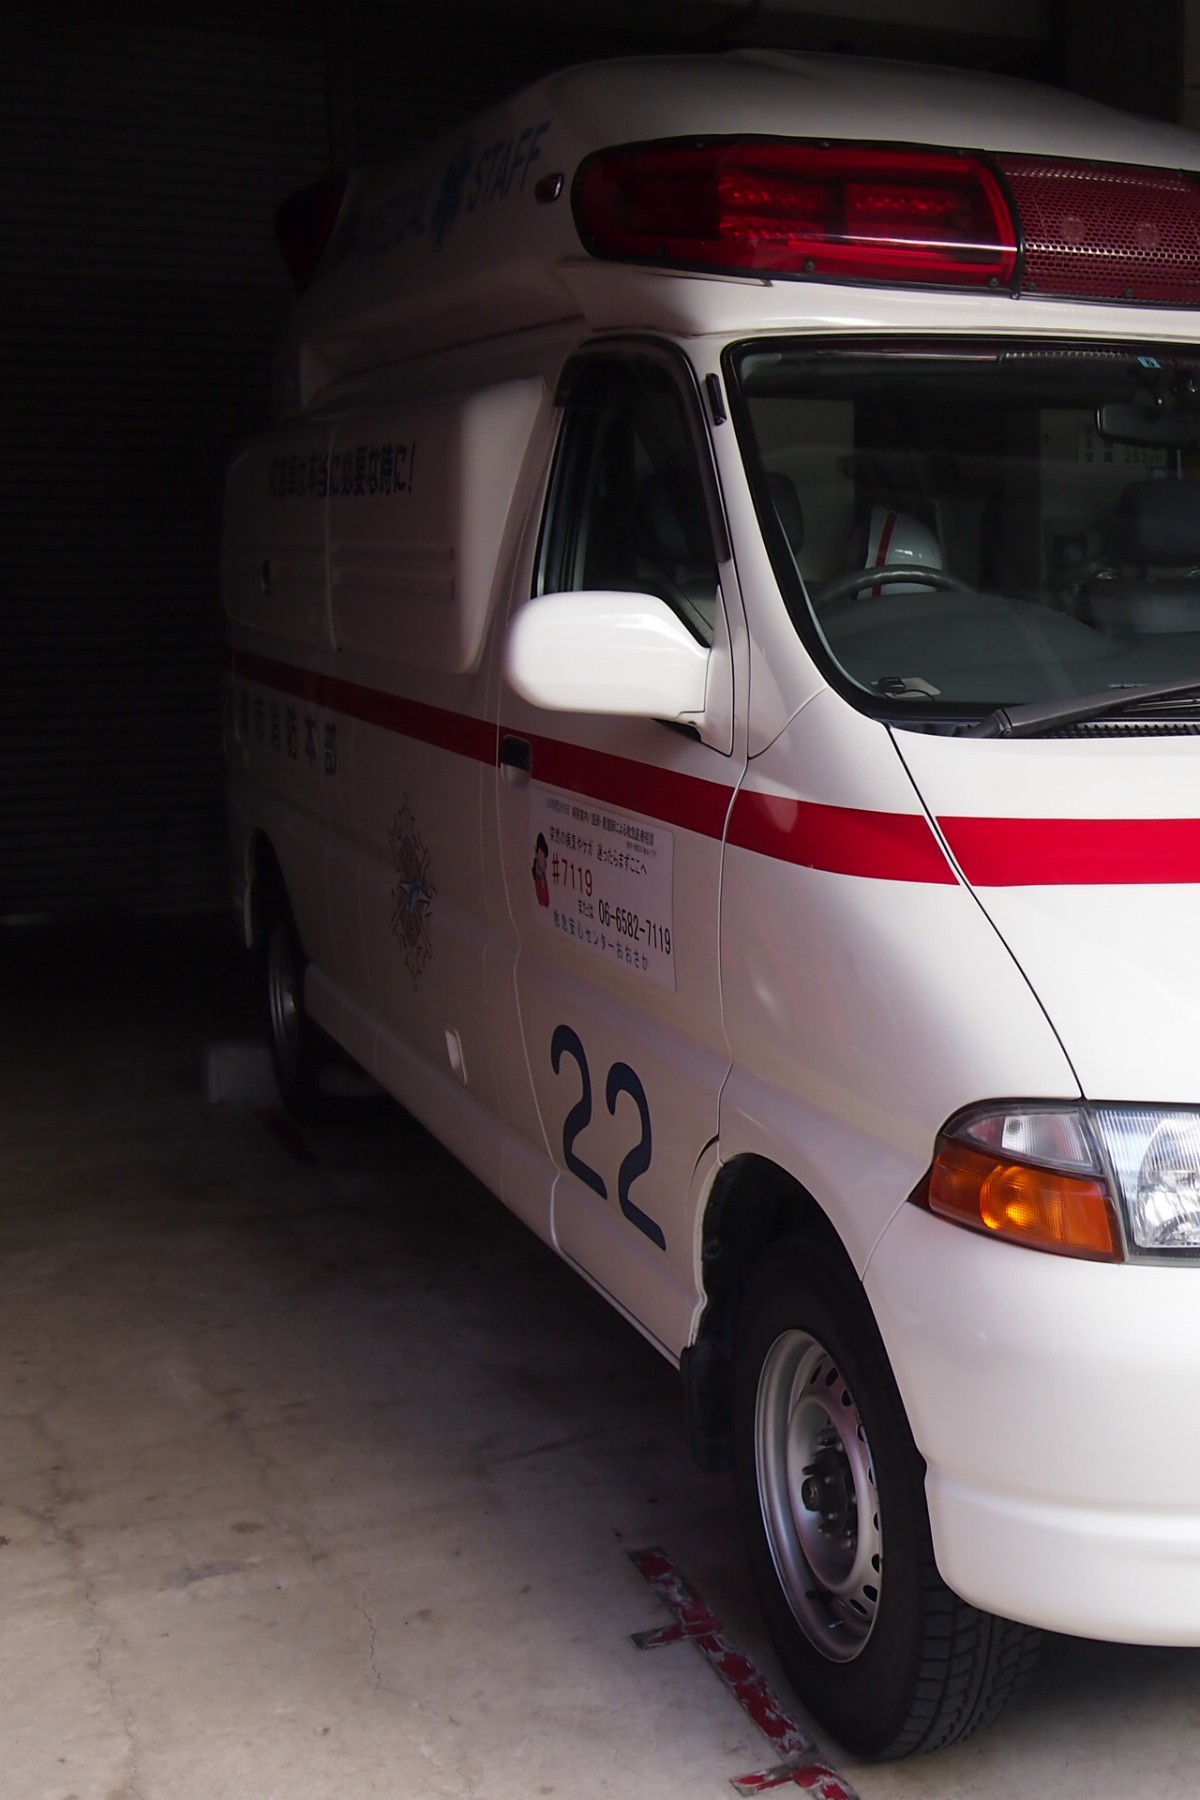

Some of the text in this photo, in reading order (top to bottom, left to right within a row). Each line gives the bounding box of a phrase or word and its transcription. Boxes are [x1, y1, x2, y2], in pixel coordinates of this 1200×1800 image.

[467, 120, 552, 214] STAFF
[552, 853, 593, 897] #7119
[553, 911, 649, 971] 救急安心センターおおさか
[577, 899, 671, 955] または 06-6582-7119
[551, 1025, 667, 1251] 22
